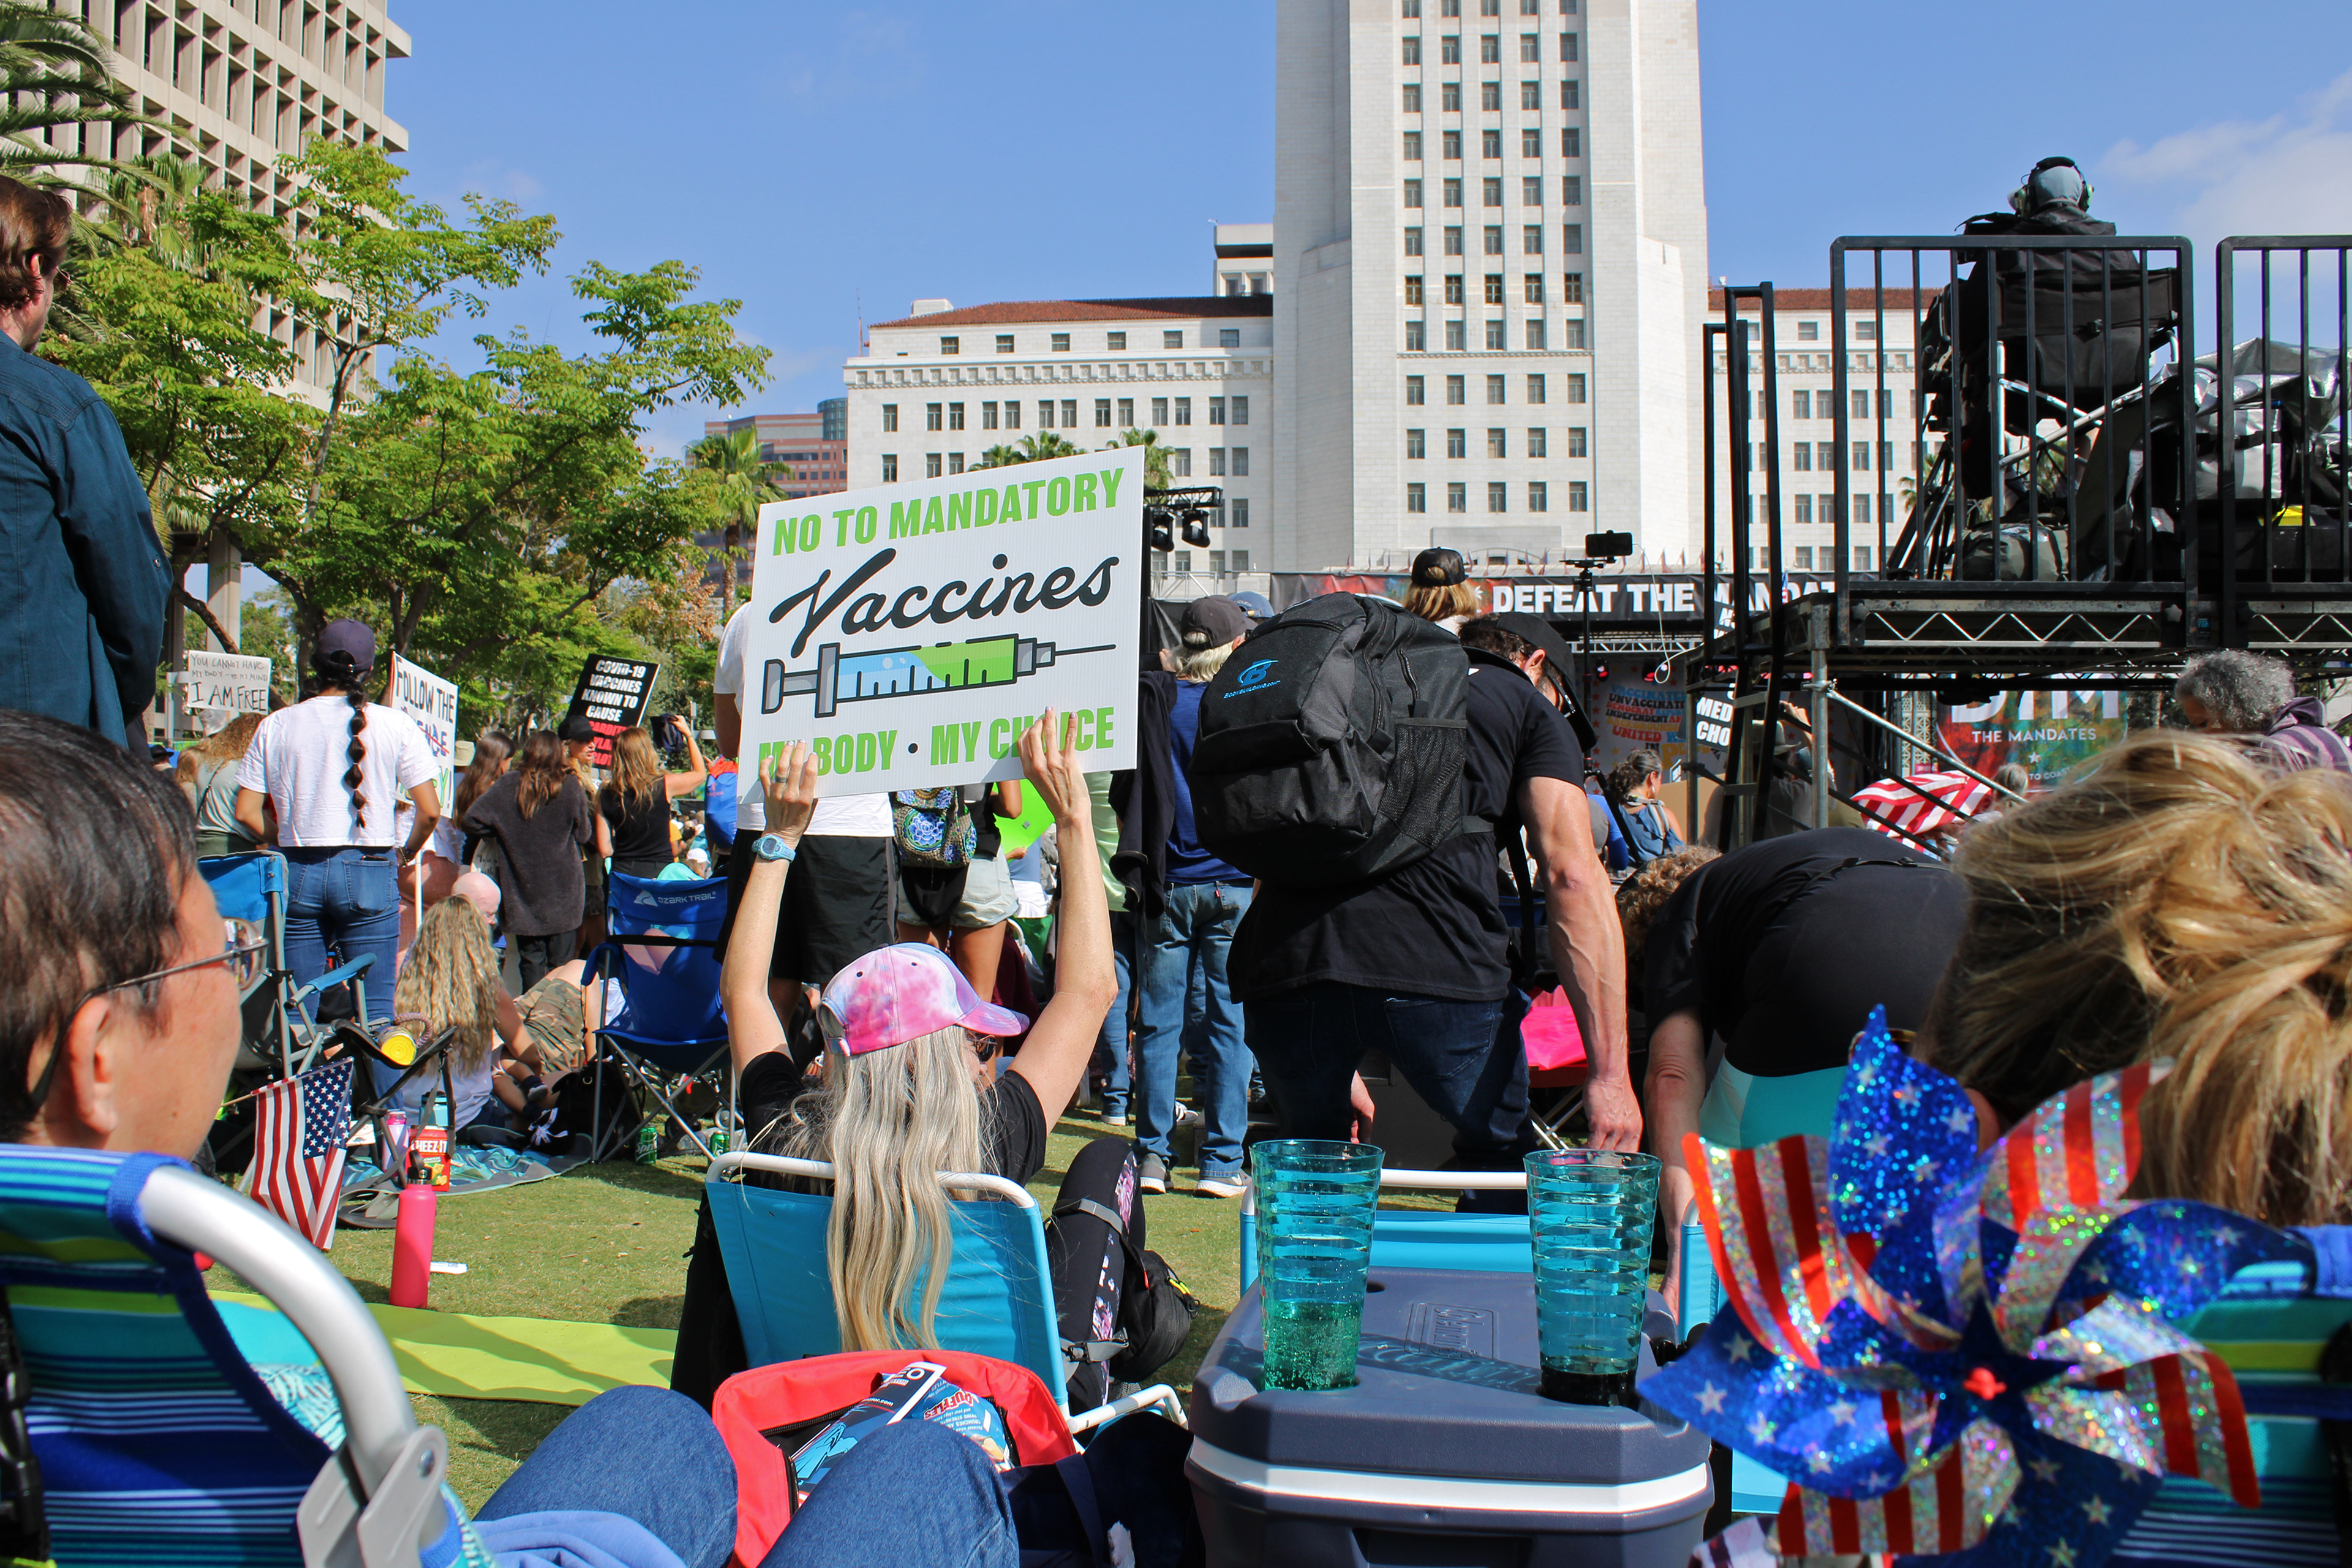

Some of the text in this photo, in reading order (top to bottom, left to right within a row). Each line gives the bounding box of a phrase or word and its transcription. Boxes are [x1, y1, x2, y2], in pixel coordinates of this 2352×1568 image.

[772, 467, 1125, 556] NO TO MANDATORY
[769, 548, 1120, 658] Vaccines
[1492, 583, 1618, 613] DEFEAT
[1626, 583, 1695, 612] THE
[190, 654, 208, 667] YOU
[211, 658, 240, 669] CANNOT
[595, 659, 647, 679] COVID-19
[394, 655, 455, 724] FOLLOW THE
[589, 674, 643, 694] VACCINES
[190, 681, 267, 711] I AM FREE
[581, 688, 639, 709] KNOWN TO
[586, 704, 624, 723] CAUSE
[812, 729, 898, 776] BODY
[930, 720, 982, 766] MY
[989, 707, 1114, 760] CHICE
[1612, 725, 1662, 742] UNITED
[1972, 728, 2097, 743] THE MANDATES
